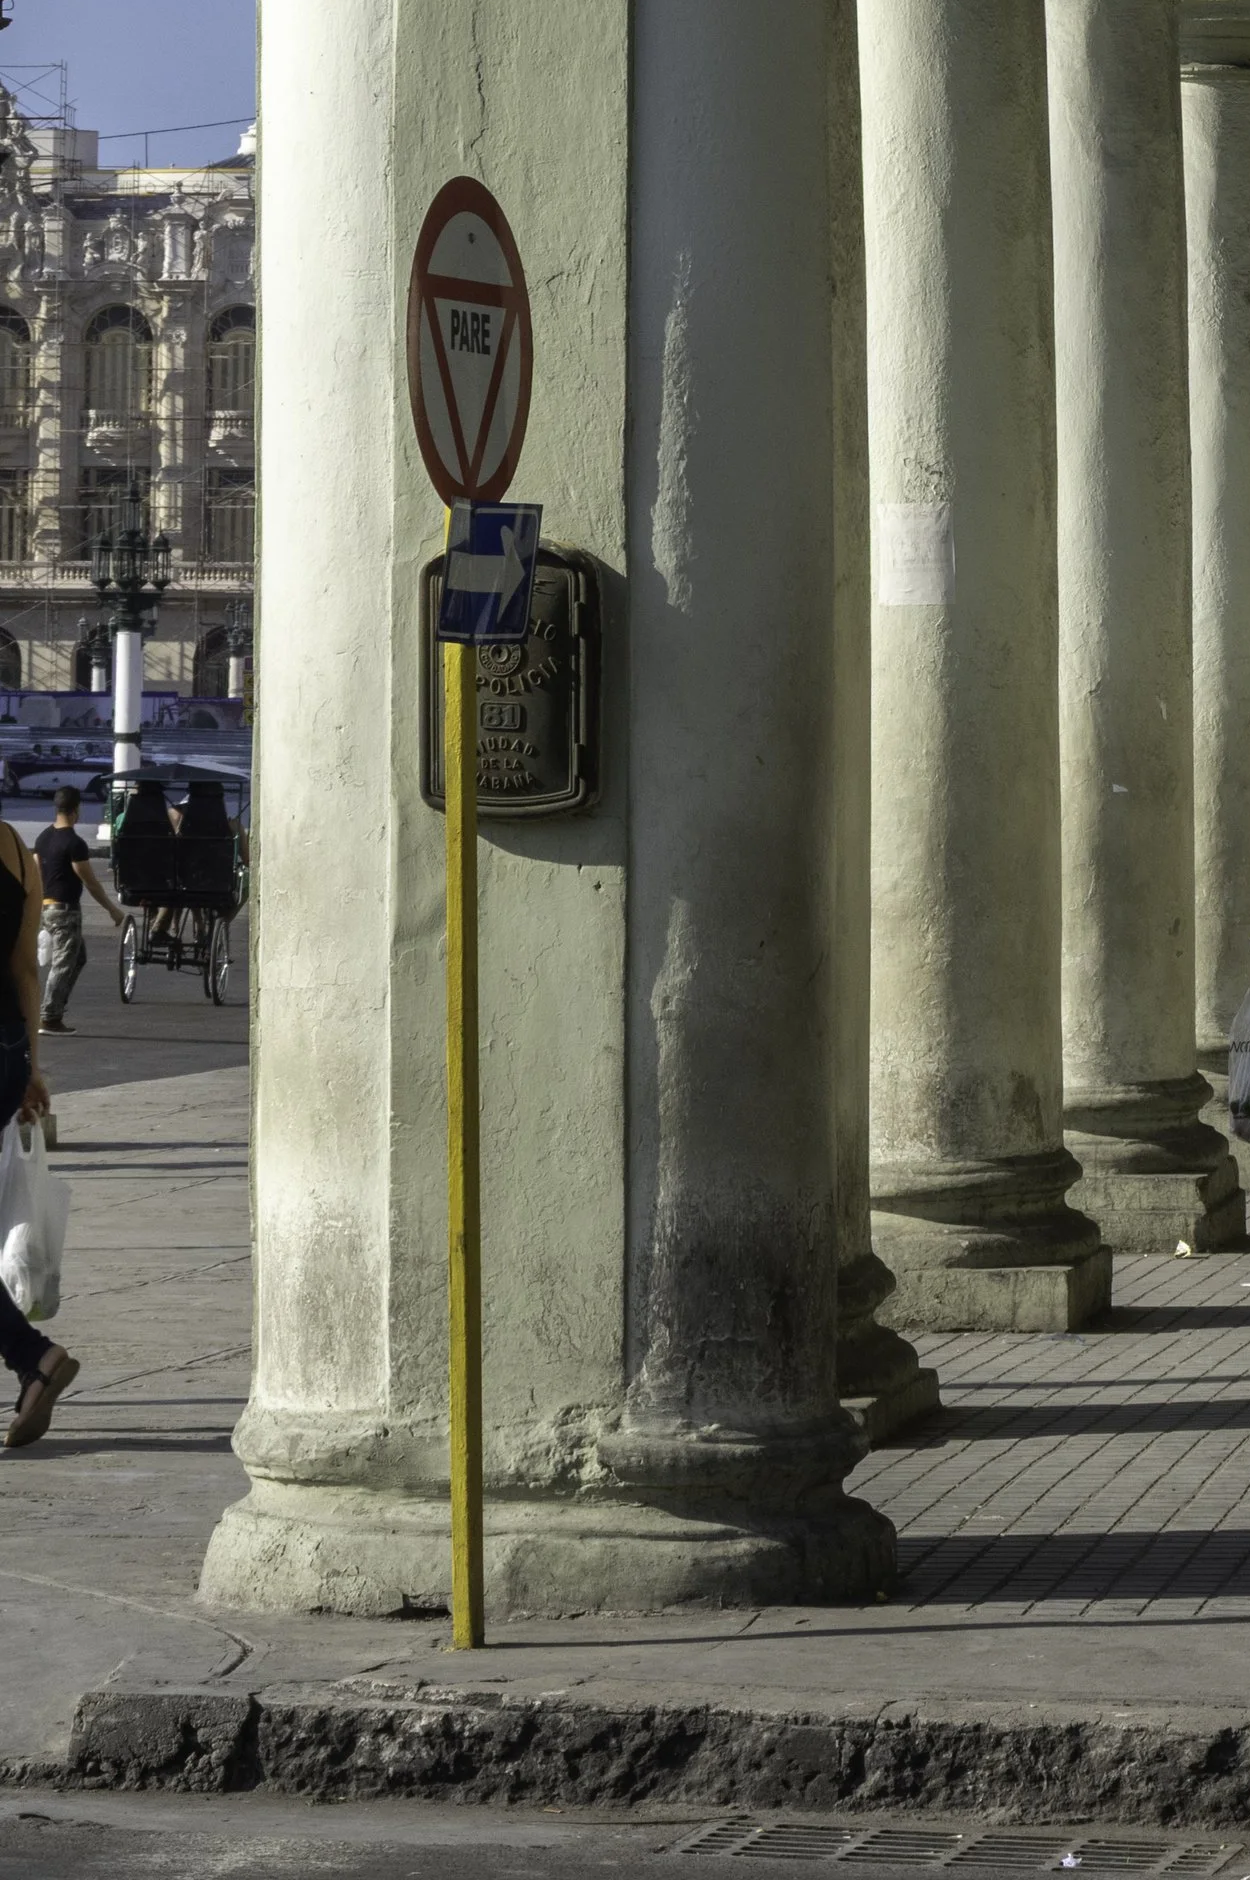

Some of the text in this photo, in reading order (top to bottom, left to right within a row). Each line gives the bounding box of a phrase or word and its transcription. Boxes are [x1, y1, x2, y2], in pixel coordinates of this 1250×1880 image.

[450, 308, 491, 356] PARE
[483, 704, 517, 727] 81
[477, 736, 534, 756] IUDAD
[481, 758, 520, 769] DE LA
